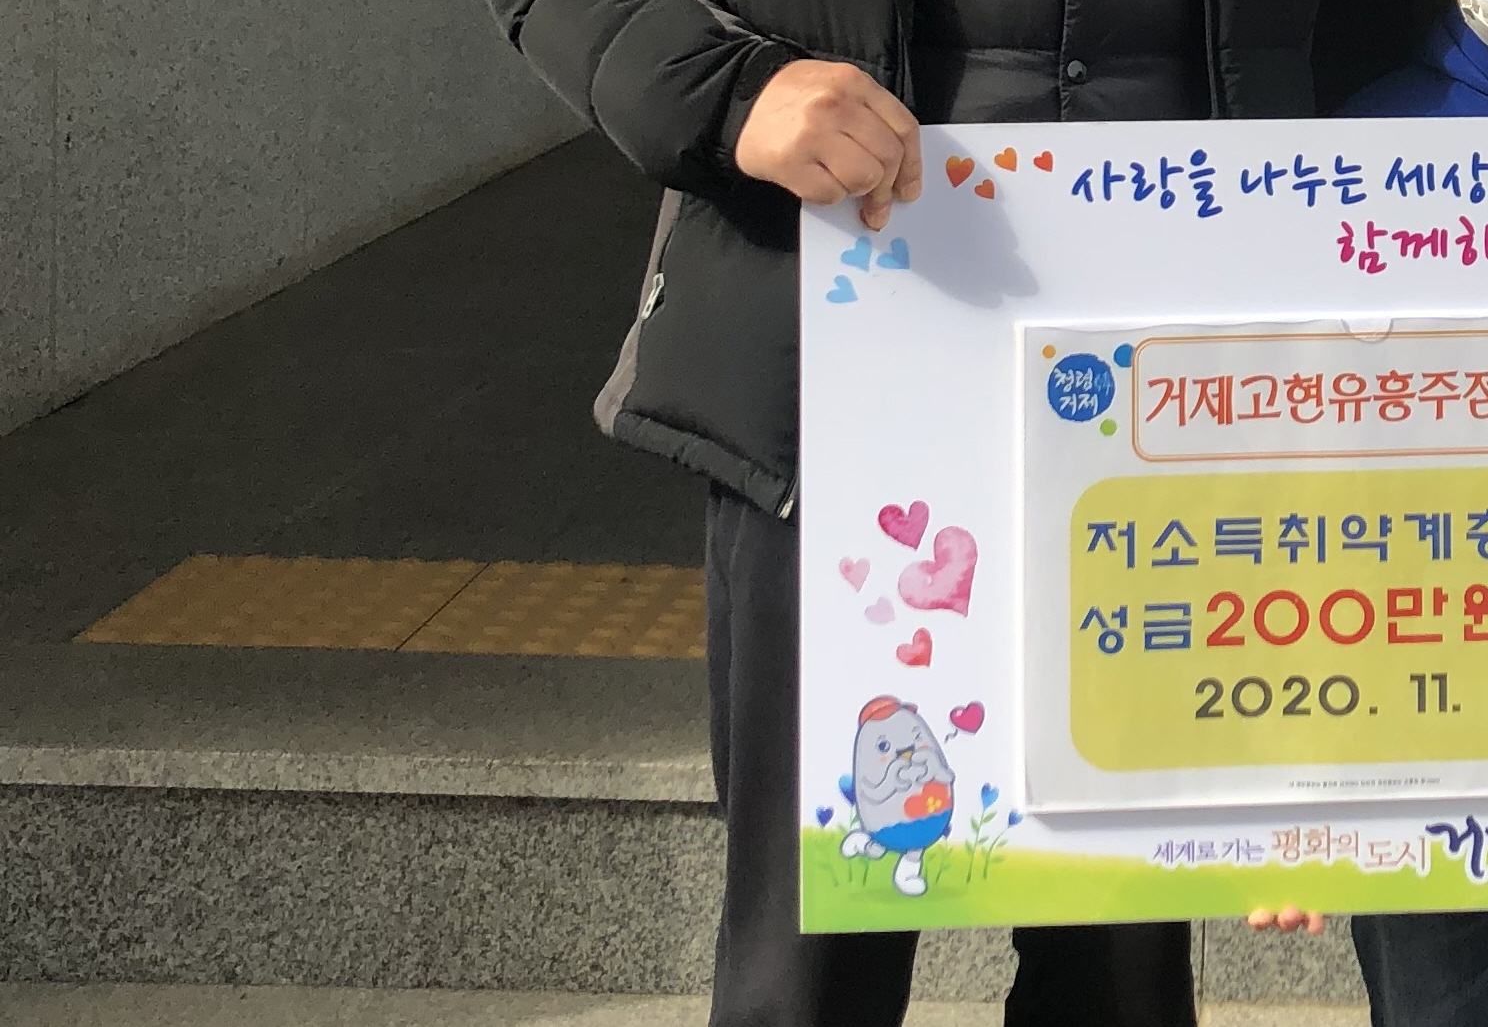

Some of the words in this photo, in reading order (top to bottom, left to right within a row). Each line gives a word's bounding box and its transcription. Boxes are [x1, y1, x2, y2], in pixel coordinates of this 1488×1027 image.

[1072, 150, 1222, 217] 사랑을
[1241, 156, 1366, 206] 나누는
[1059, 393, 1099, 416] 거제
[1194, 674, 1379, 720] 2020.
[1409, 672, 1462, 714] 11.
[1271, 825, 1359, 862] 평화의
[1365, 835, 1425, 871] 도시
